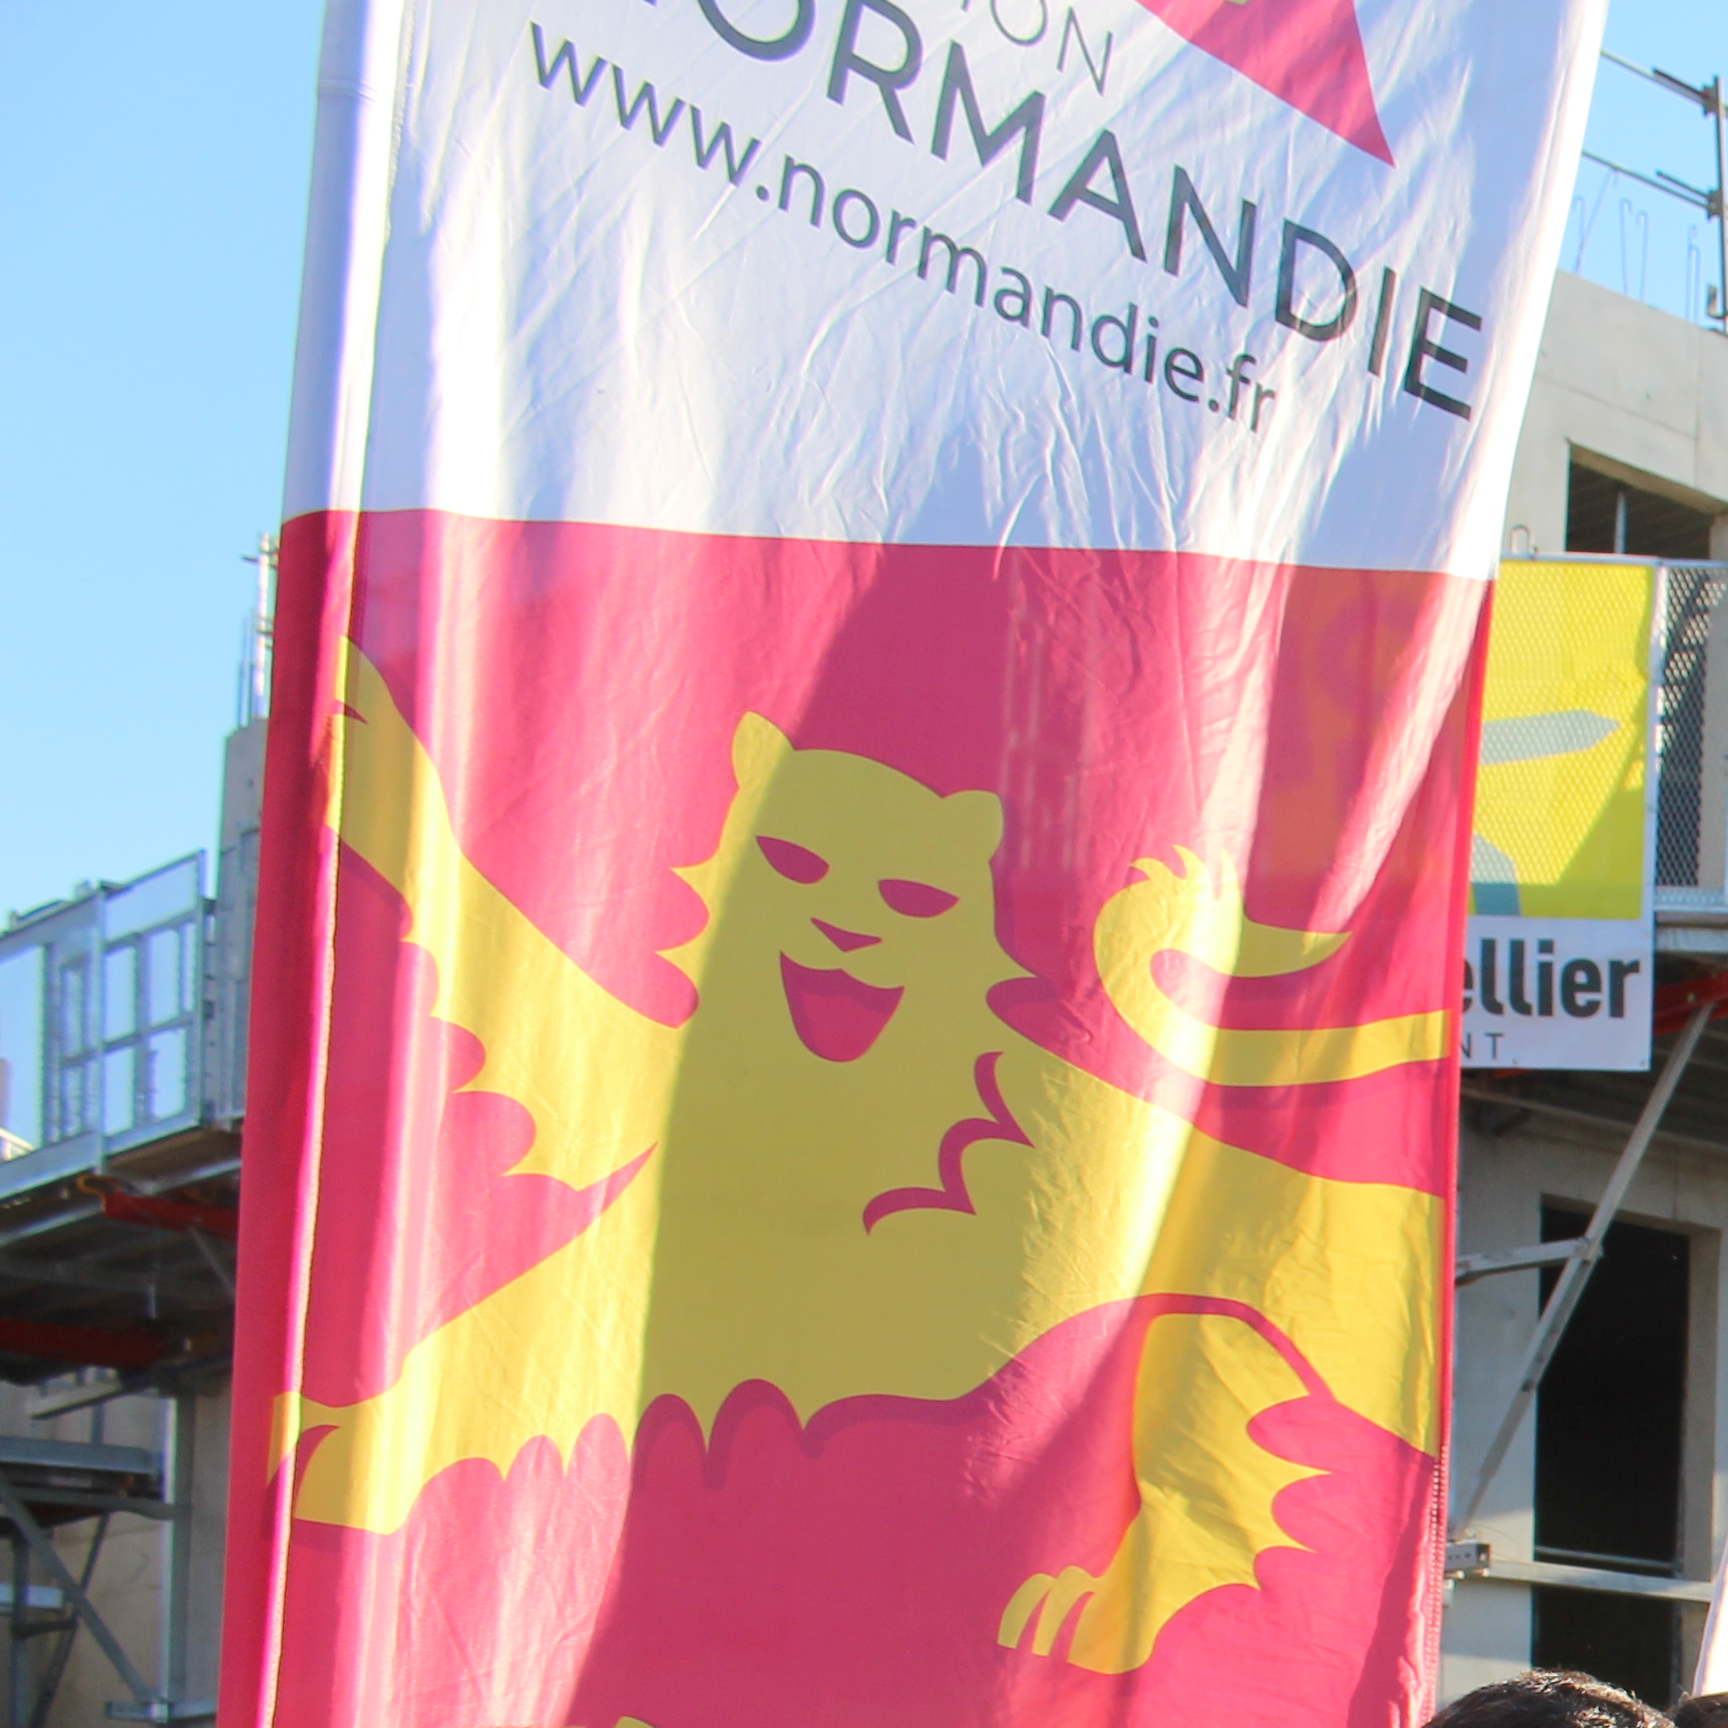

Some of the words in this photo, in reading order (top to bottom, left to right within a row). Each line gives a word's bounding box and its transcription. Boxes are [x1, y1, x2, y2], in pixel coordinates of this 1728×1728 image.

[962, 0, 1114, 97] ON
[529, 19, 1277, 433] www.normandie.fr
[640, 0, 1483, 421] ORMANDIE
[1463, 936, 1642, 1020] llier
